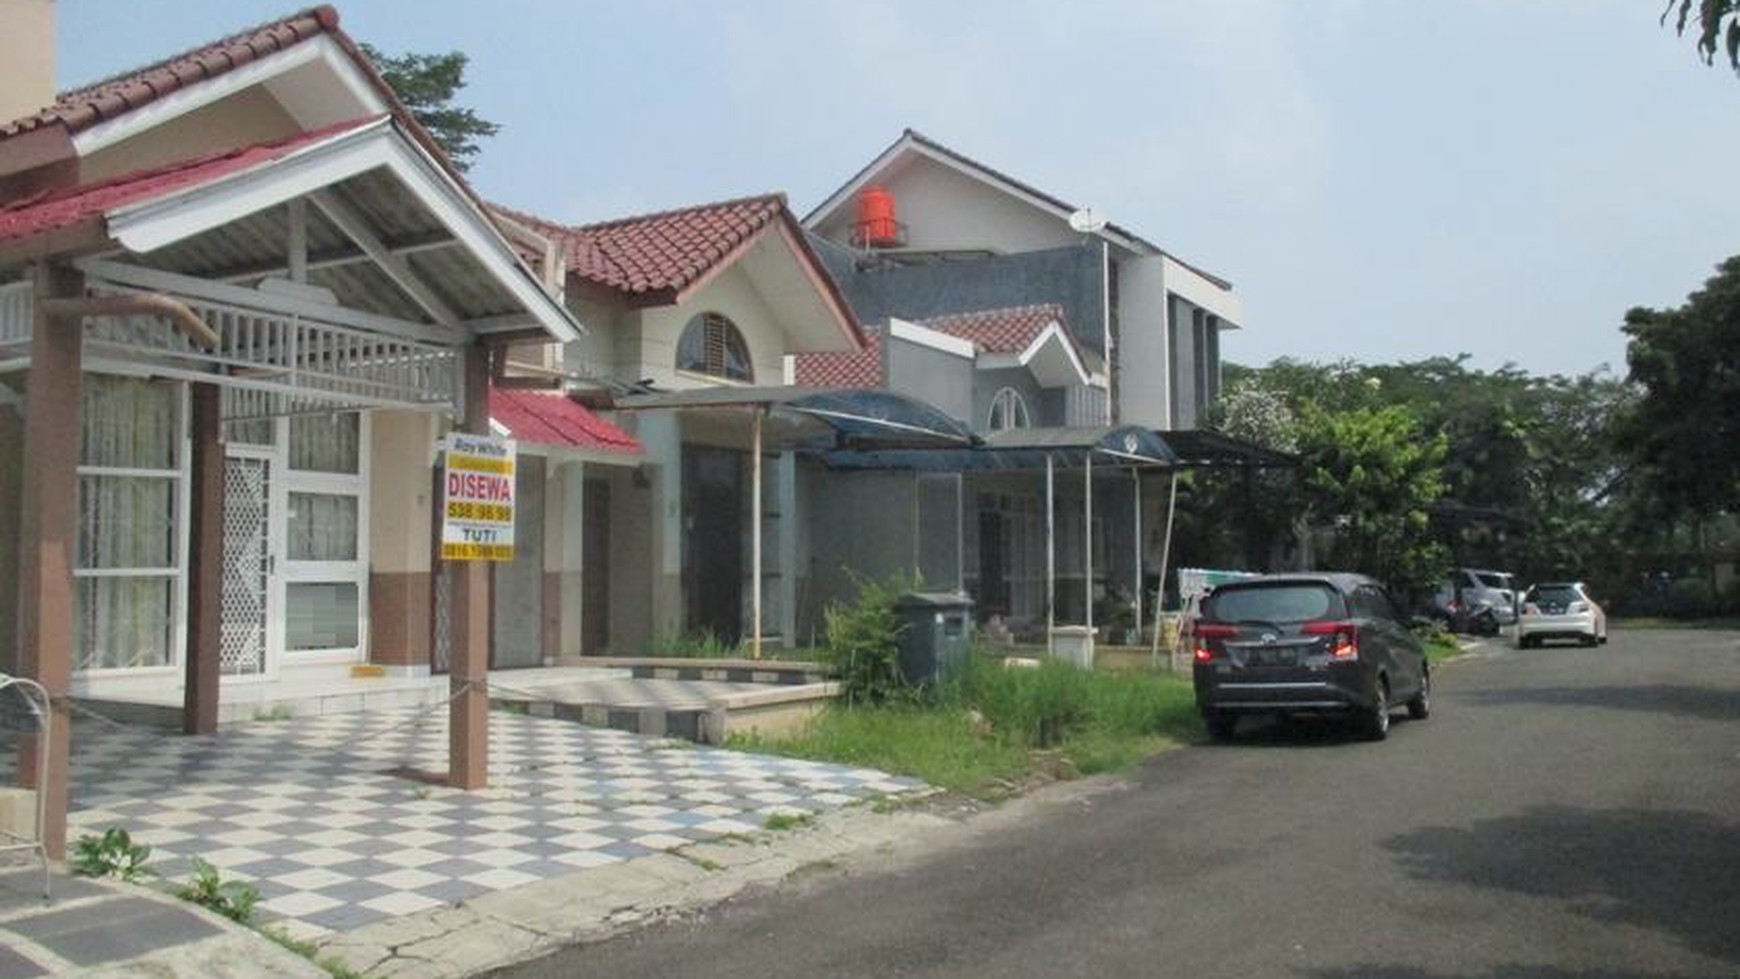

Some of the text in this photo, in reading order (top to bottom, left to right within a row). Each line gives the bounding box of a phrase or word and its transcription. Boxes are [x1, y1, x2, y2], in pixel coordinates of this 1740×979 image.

[448, 472, 512, 502] DISEWA
[448, 501, 473, 518] 538
[462, 528, 497, 542] TUTI
